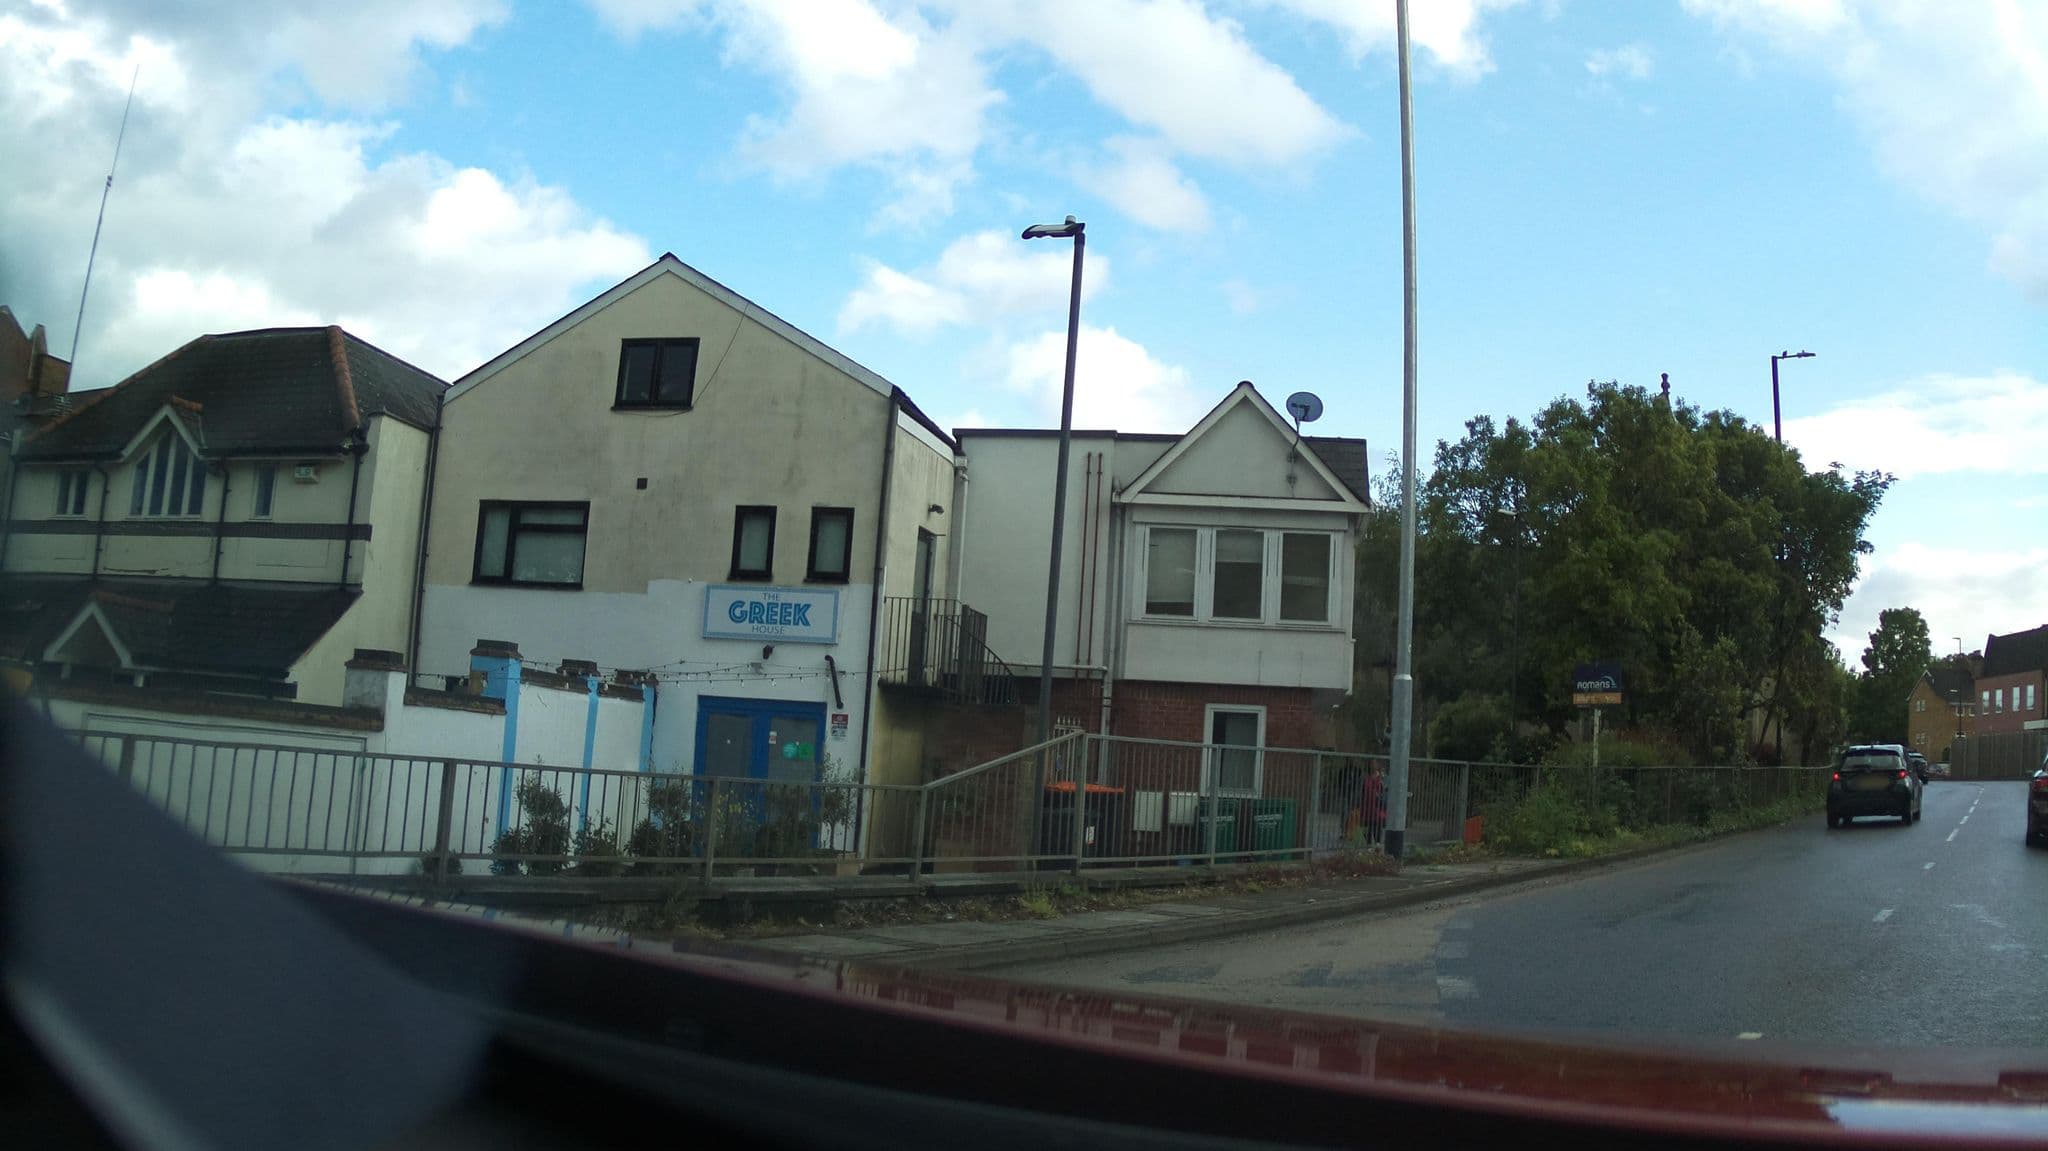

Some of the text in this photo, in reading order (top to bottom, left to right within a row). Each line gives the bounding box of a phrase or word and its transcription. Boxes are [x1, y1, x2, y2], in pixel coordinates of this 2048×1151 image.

[762, 592, 780, 601] THE
[728, 600, 812, 627] GREEK
[752, 625, 785, 635] HOUSE
